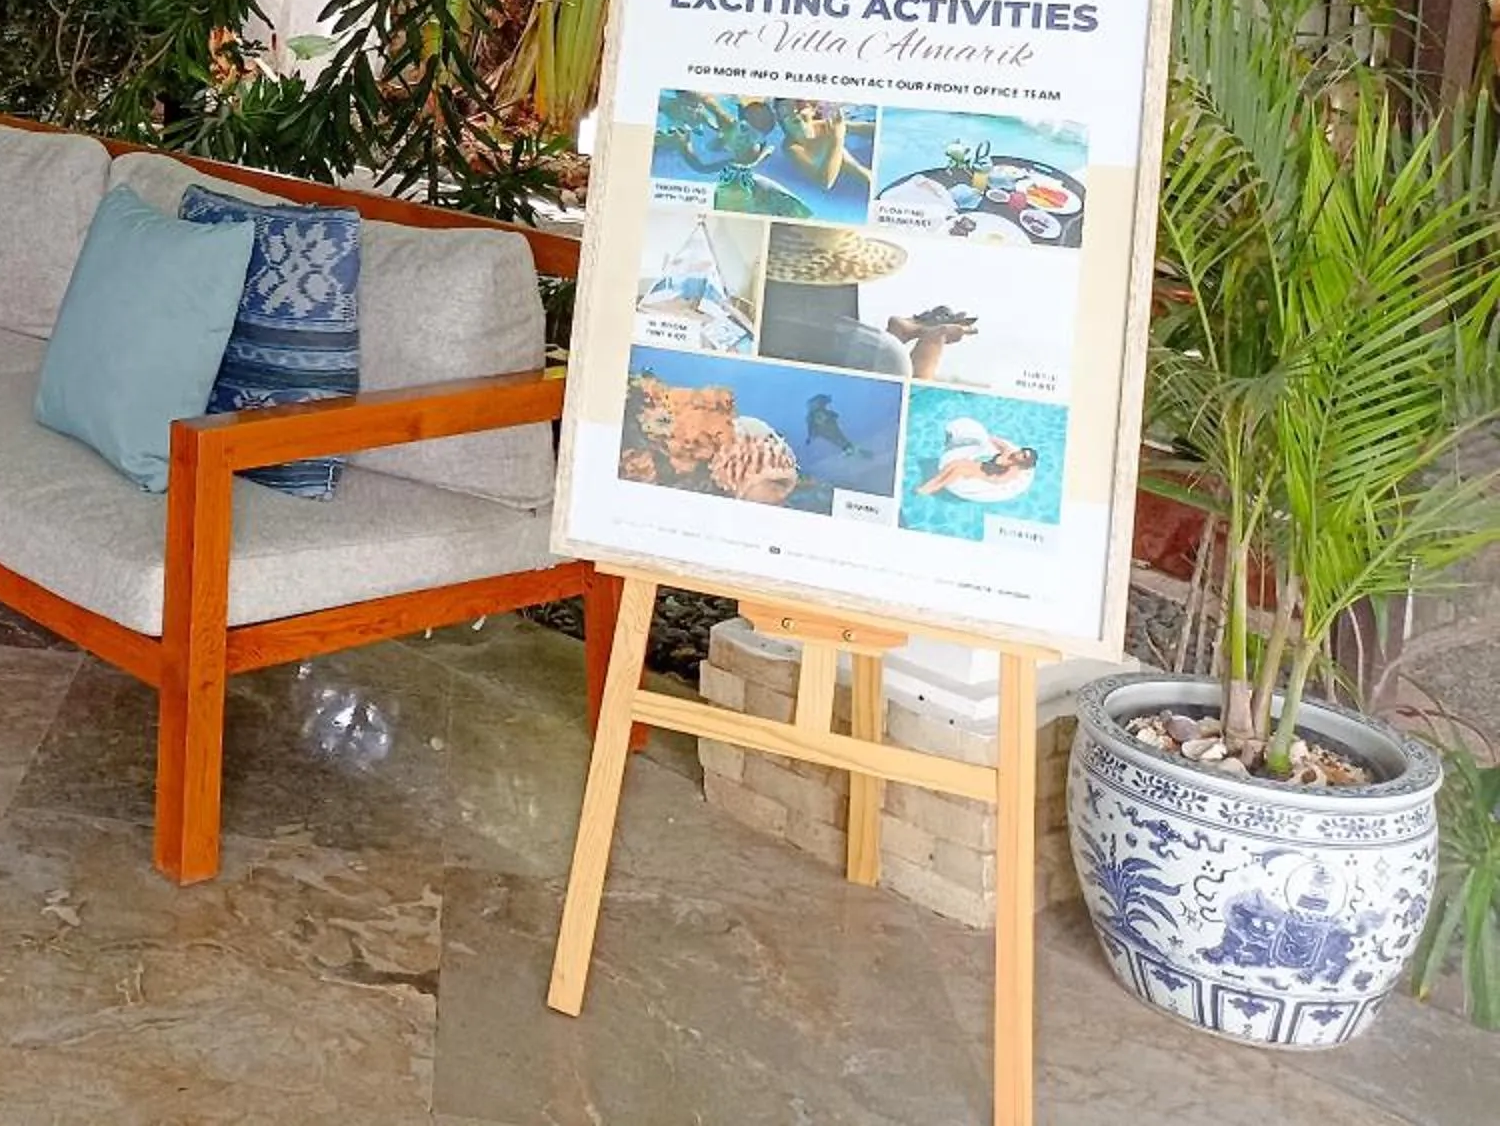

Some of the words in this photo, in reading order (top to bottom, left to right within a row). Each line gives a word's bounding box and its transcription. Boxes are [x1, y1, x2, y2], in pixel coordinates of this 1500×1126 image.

[714, 29, 750, 49] at
[757, 19, 848, 53] Villa
[857, 27, 1035, 68] Almarik
[687, 64, 711, 76] FOR
[713, 66, 746, 78] MORE
[785, 72, 829, 84] PLEASE
[831, 75, 893, 89] CONTACT
[895, 79, 924, 91] OUR
[926, 81, 969, 94] FRONT
[973, 85, 1018, 99] OFFICE
[1023, 88, 1062, 101] TEAM
